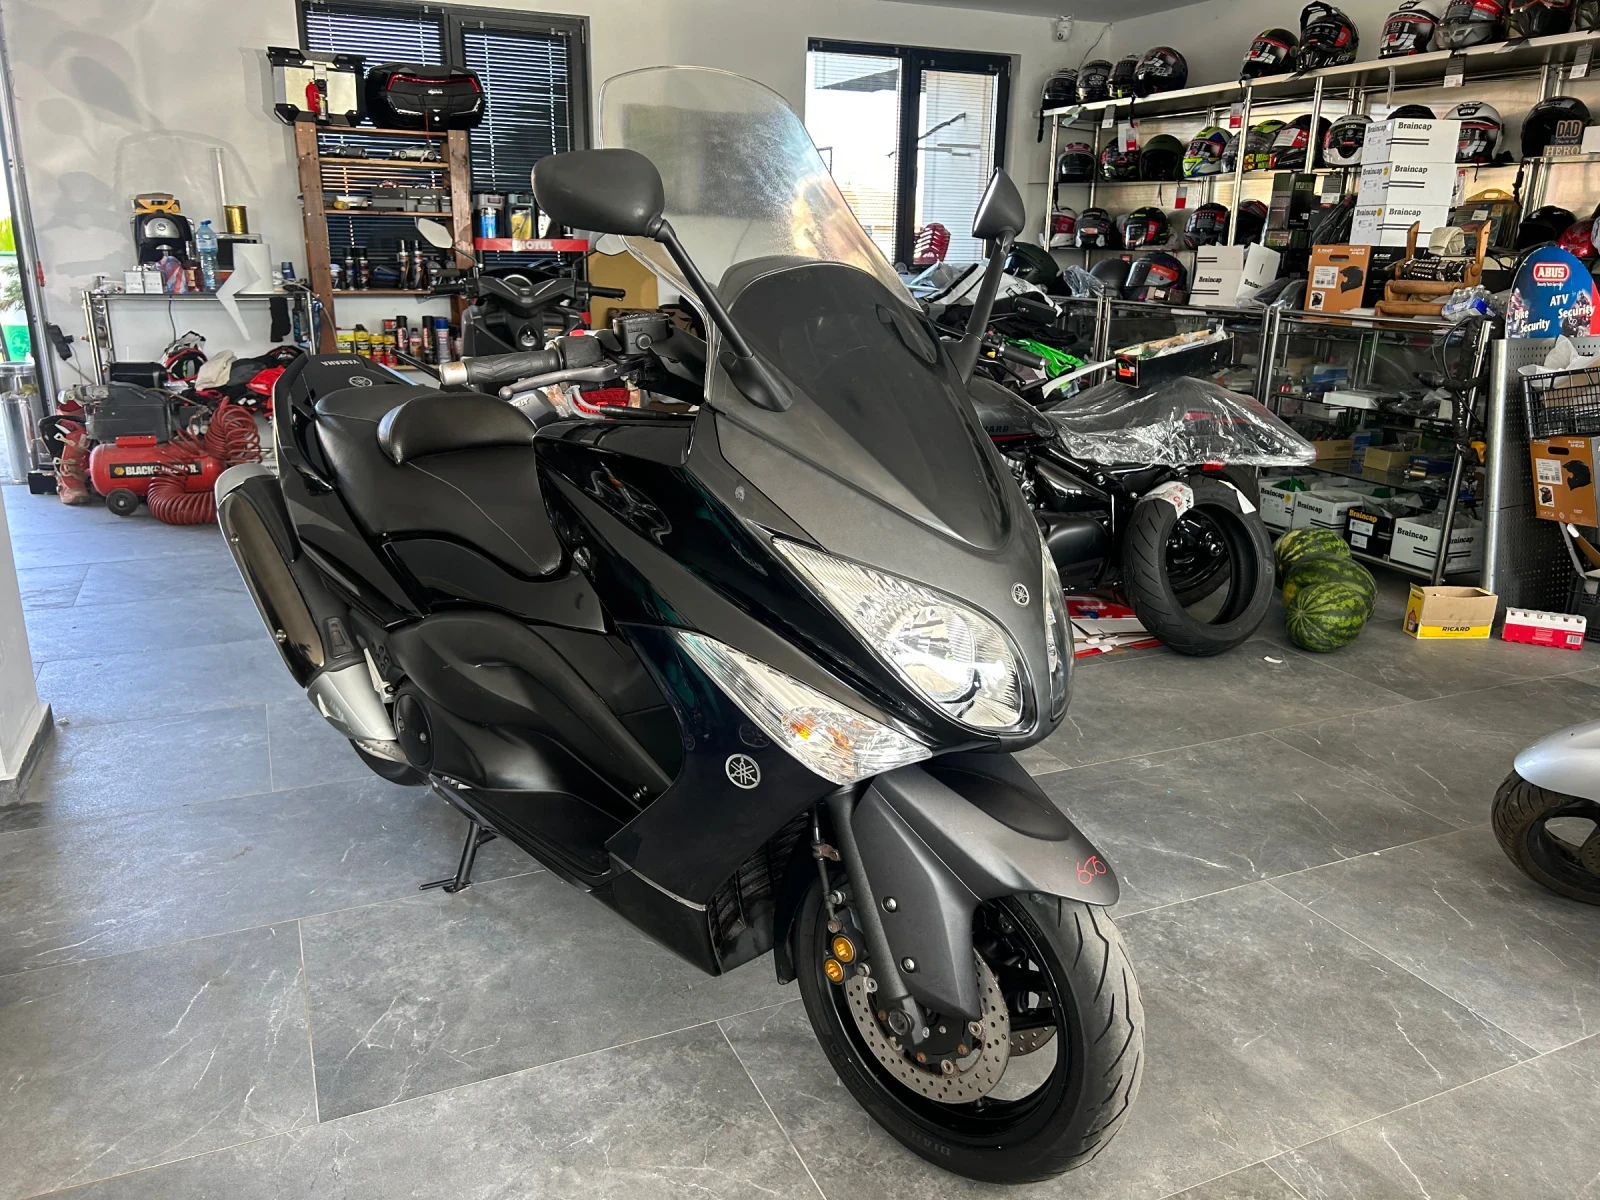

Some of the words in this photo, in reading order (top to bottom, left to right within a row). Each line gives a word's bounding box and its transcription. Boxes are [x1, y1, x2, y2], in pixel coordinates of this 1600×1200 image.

[1367, 124, 1387, 133] Braincap
[1398, 122, 1432, 131] Braincap
[1556, 120, 1582, 138] DAD
[1545, 145, 1580, 156] HERO
[1362, 167, 1383, 175] Braincap
[1394, 164, 1428, 174] Braincap
[1356, 208, 1377, 216] Braincap
[1388, 208, 1421, 217] Braincap
[517, 240, 554, 250] MOTUL
[1537, 266, 1565, 278] ABUS
[1550, 294, 1569, 306] ATV
[1514, 309, 1529, 320] Bike
[1558, 305, 1595, 319] Security
[1520, 319, 1550, 333] Security
[125, 466, 154, 475] BLACK
[1261, 487, 1285, 500] Braincap
[1297, 501, 1323, 514] Braincap
[1349, 509, 1378, 523] Braincap
[1397, 527, 1428, 541] Braincap
